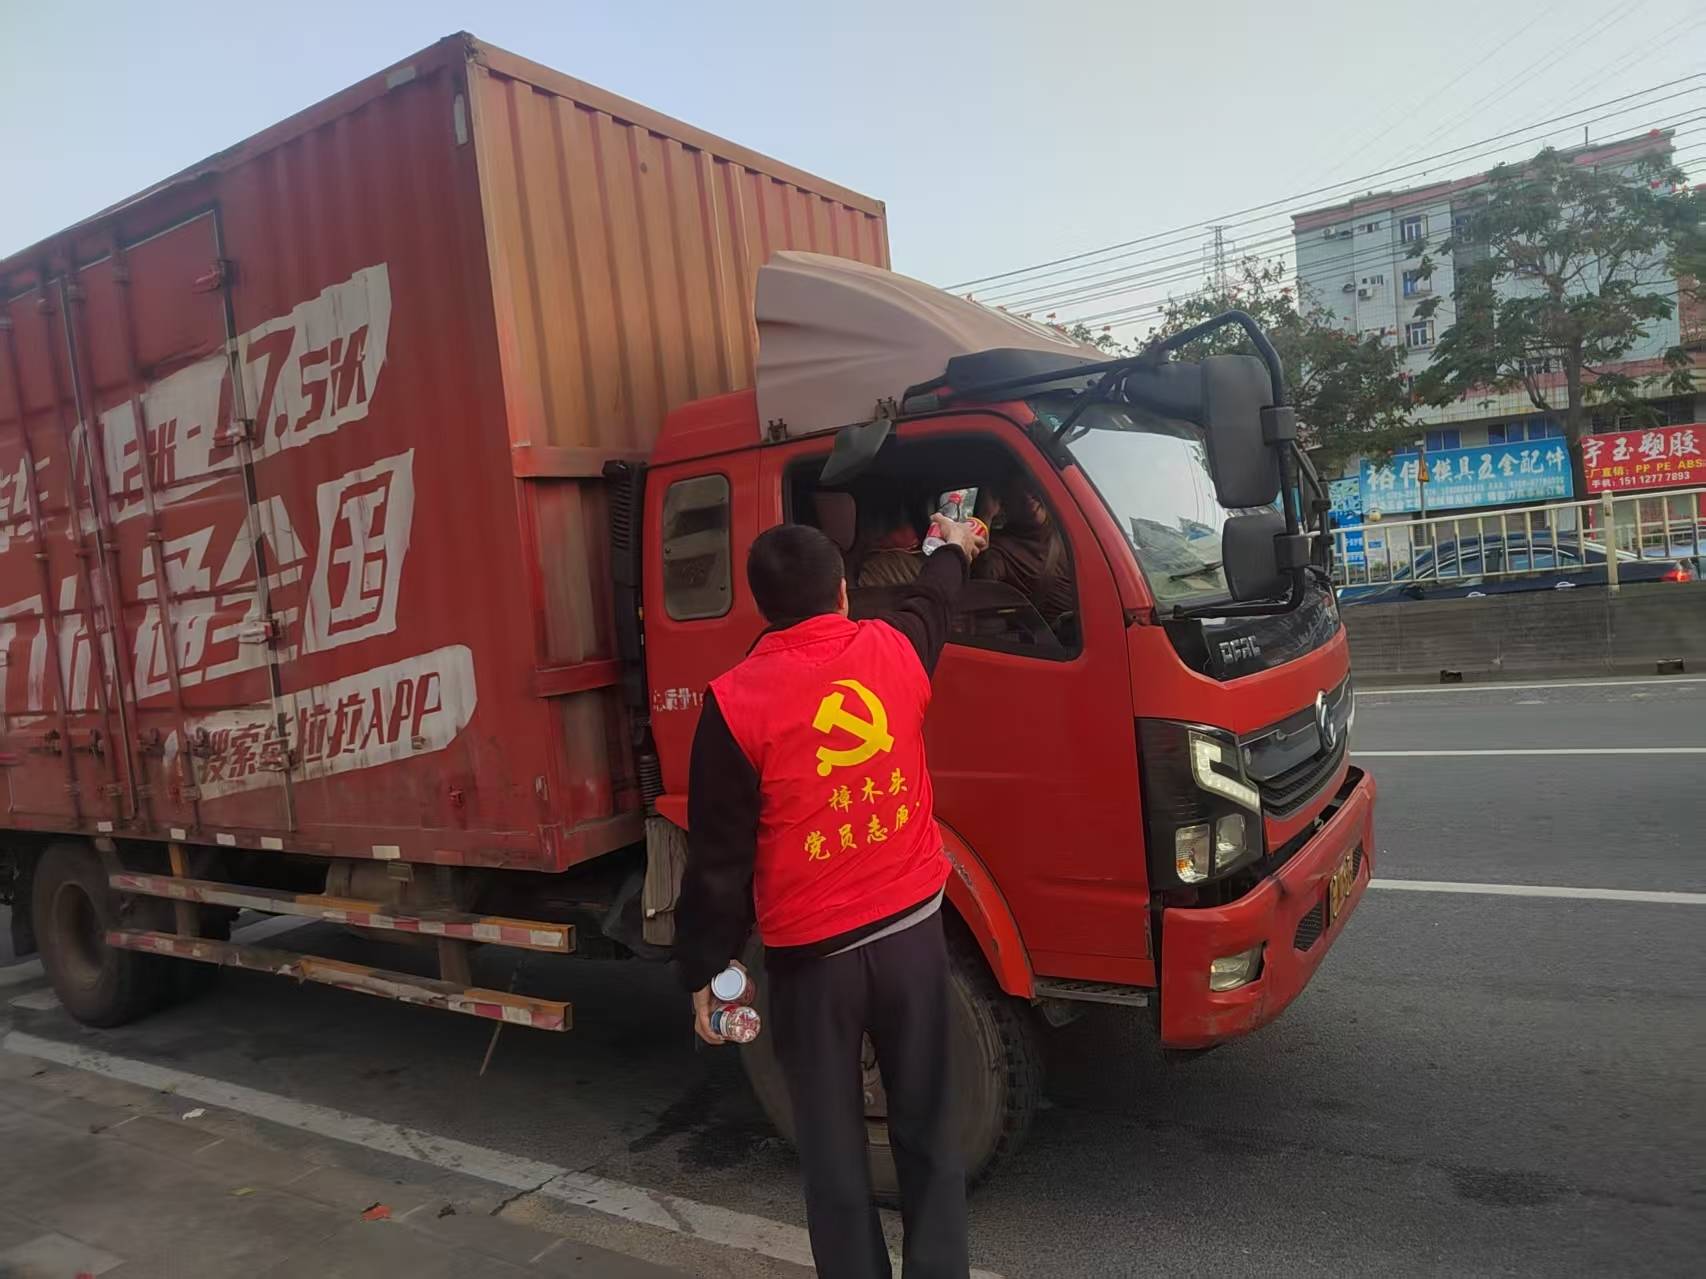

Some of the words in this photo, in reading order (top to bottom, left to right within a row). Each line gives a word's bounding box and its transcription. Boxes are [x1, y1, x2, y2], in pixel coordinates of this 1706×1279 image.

[1619, 476, 1636, 486] 151
[1636, 464, 1651, 474] PP
[1657, 462, 1671, 472] PE
[1678, 458, 1703, 469] ABS
[828, 767, 908, 813] 樟木头
[803, 801, 921, 862] 党员志愿
